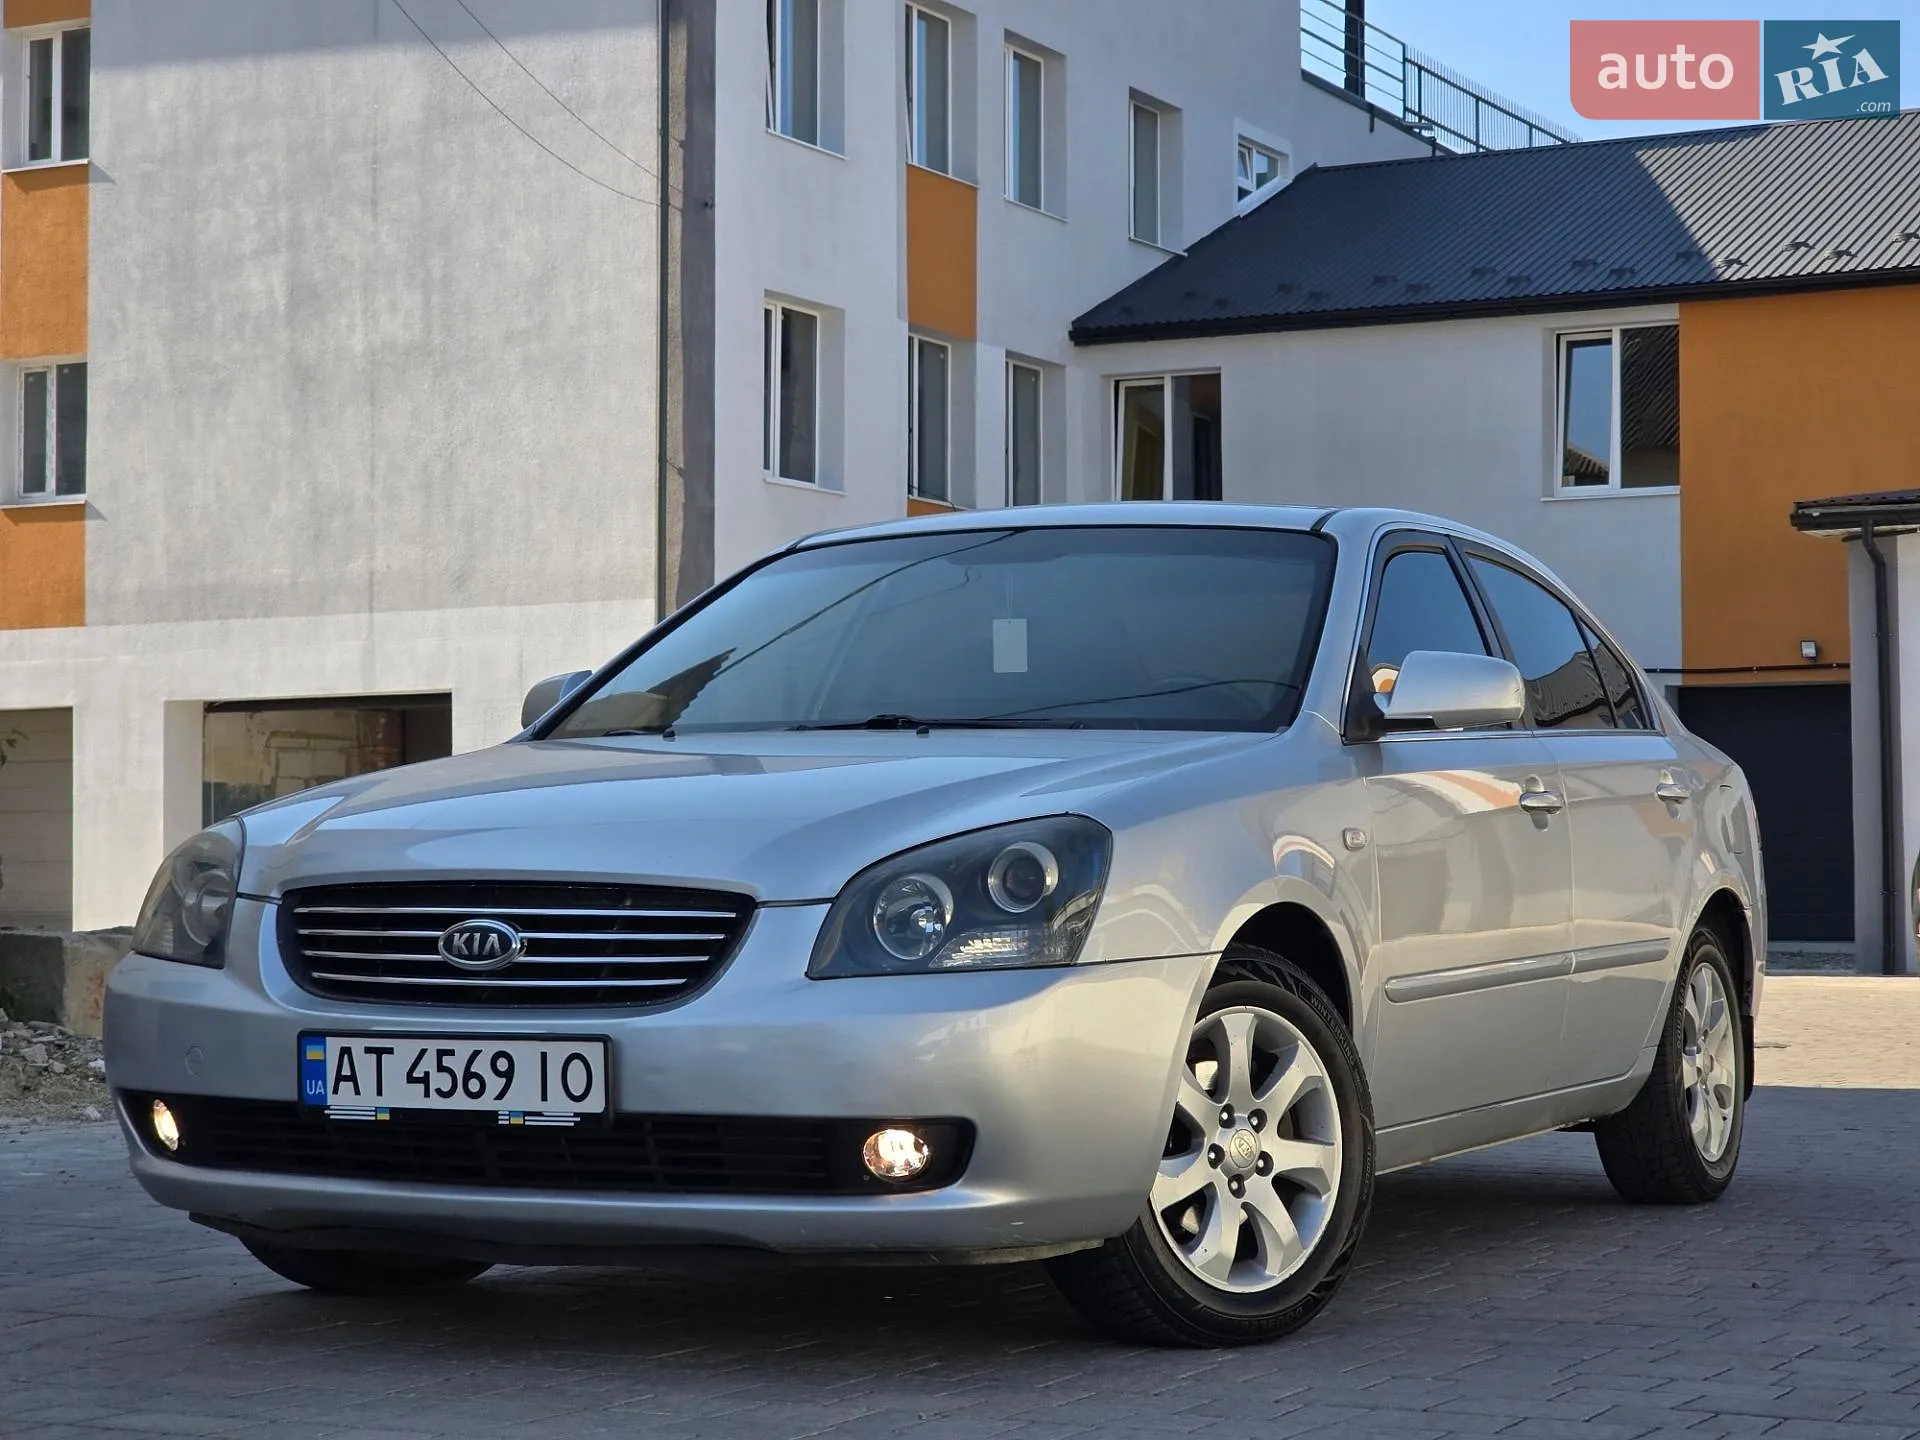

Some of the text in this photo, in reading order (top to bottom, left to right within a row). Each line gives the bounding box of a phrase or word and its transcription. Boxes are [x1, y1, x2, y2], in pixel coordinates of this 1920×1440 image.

[452, 933, 502, 956] KIA
[332, 1045, 394, 1097] AT
[406, 1047, 515, 1100] 4569
[306, 1079, 325, 1095] UA
